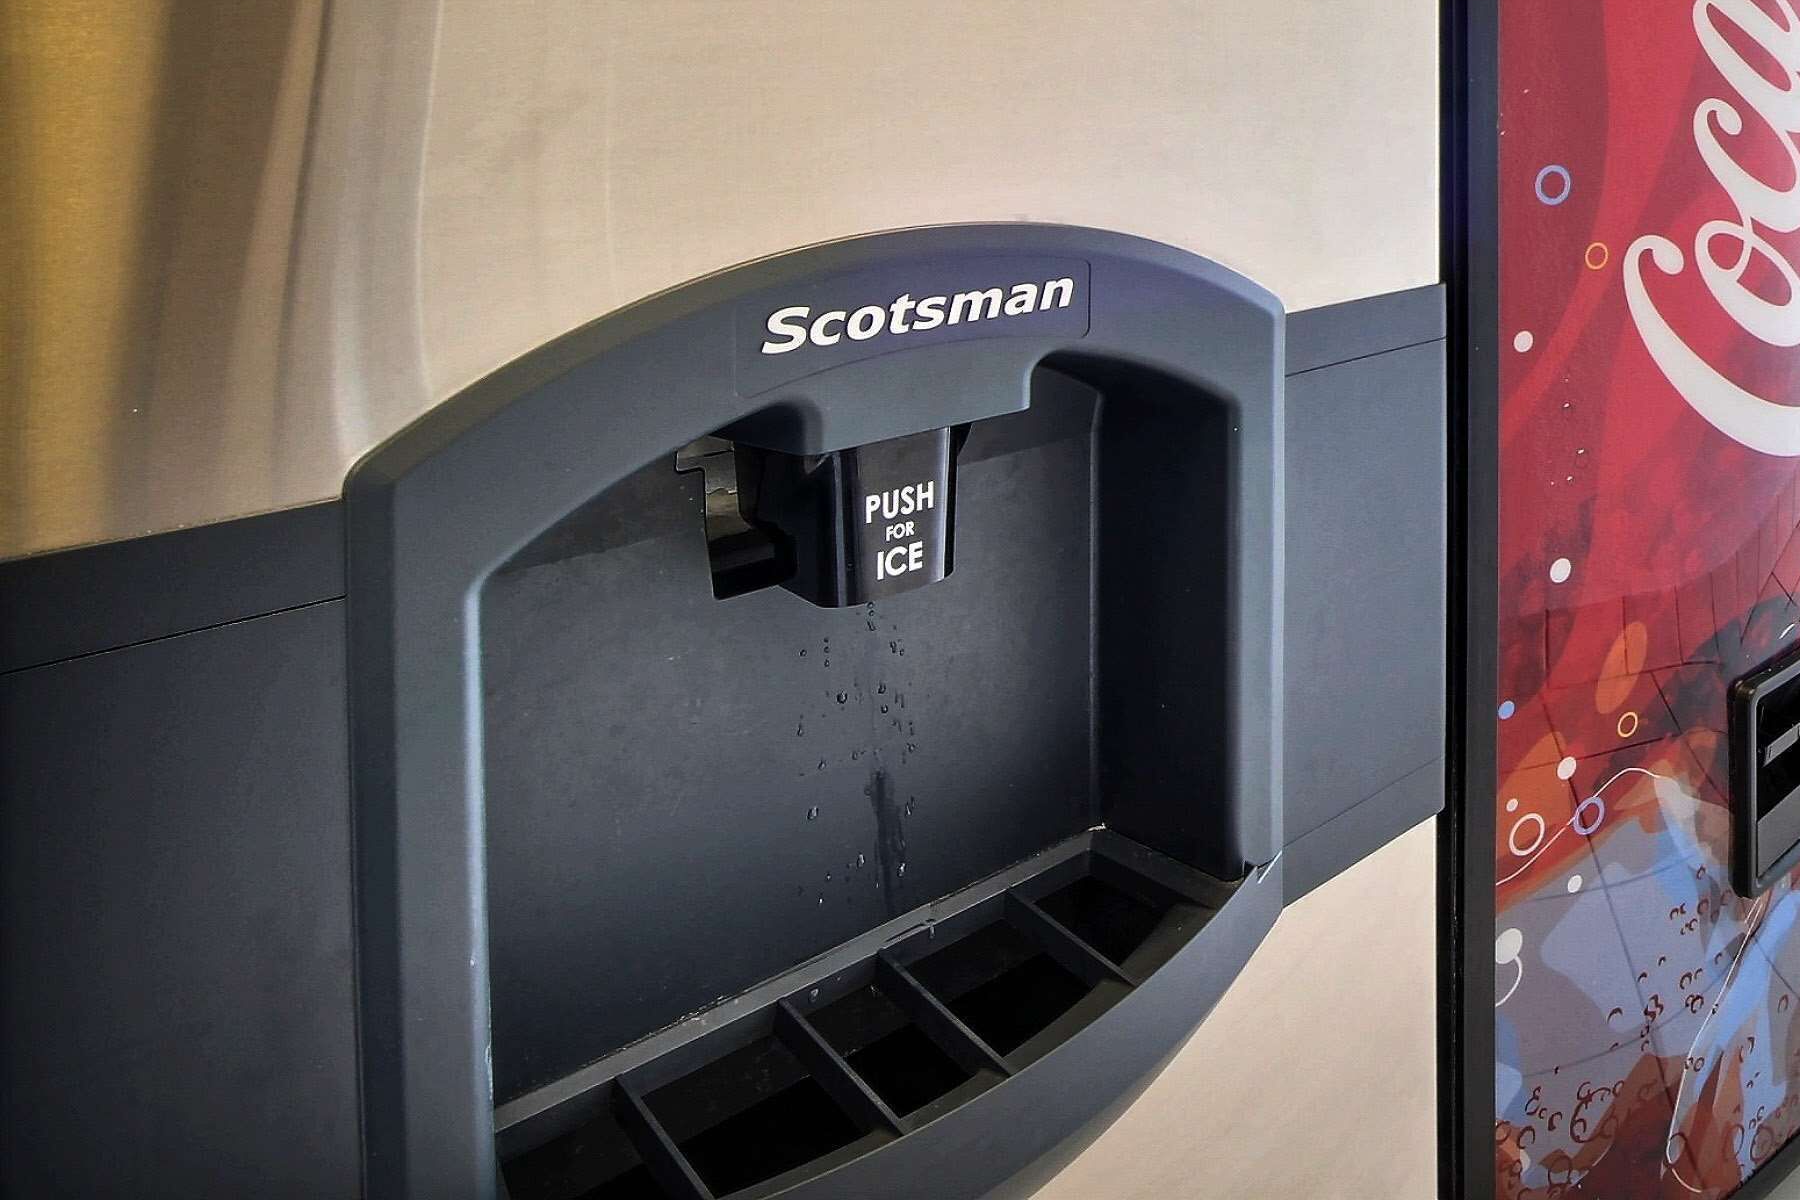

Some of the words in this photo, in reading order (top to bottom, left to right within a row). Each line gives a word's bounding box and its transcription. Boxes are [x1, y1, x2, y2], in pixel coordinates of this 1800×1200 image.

[761, 276, 1075, 355] Scotsman
[865, 480, 935, 524] PUSH
[886, 520, 915, 542] FOR
[877, 540, 924, 581] ICE
